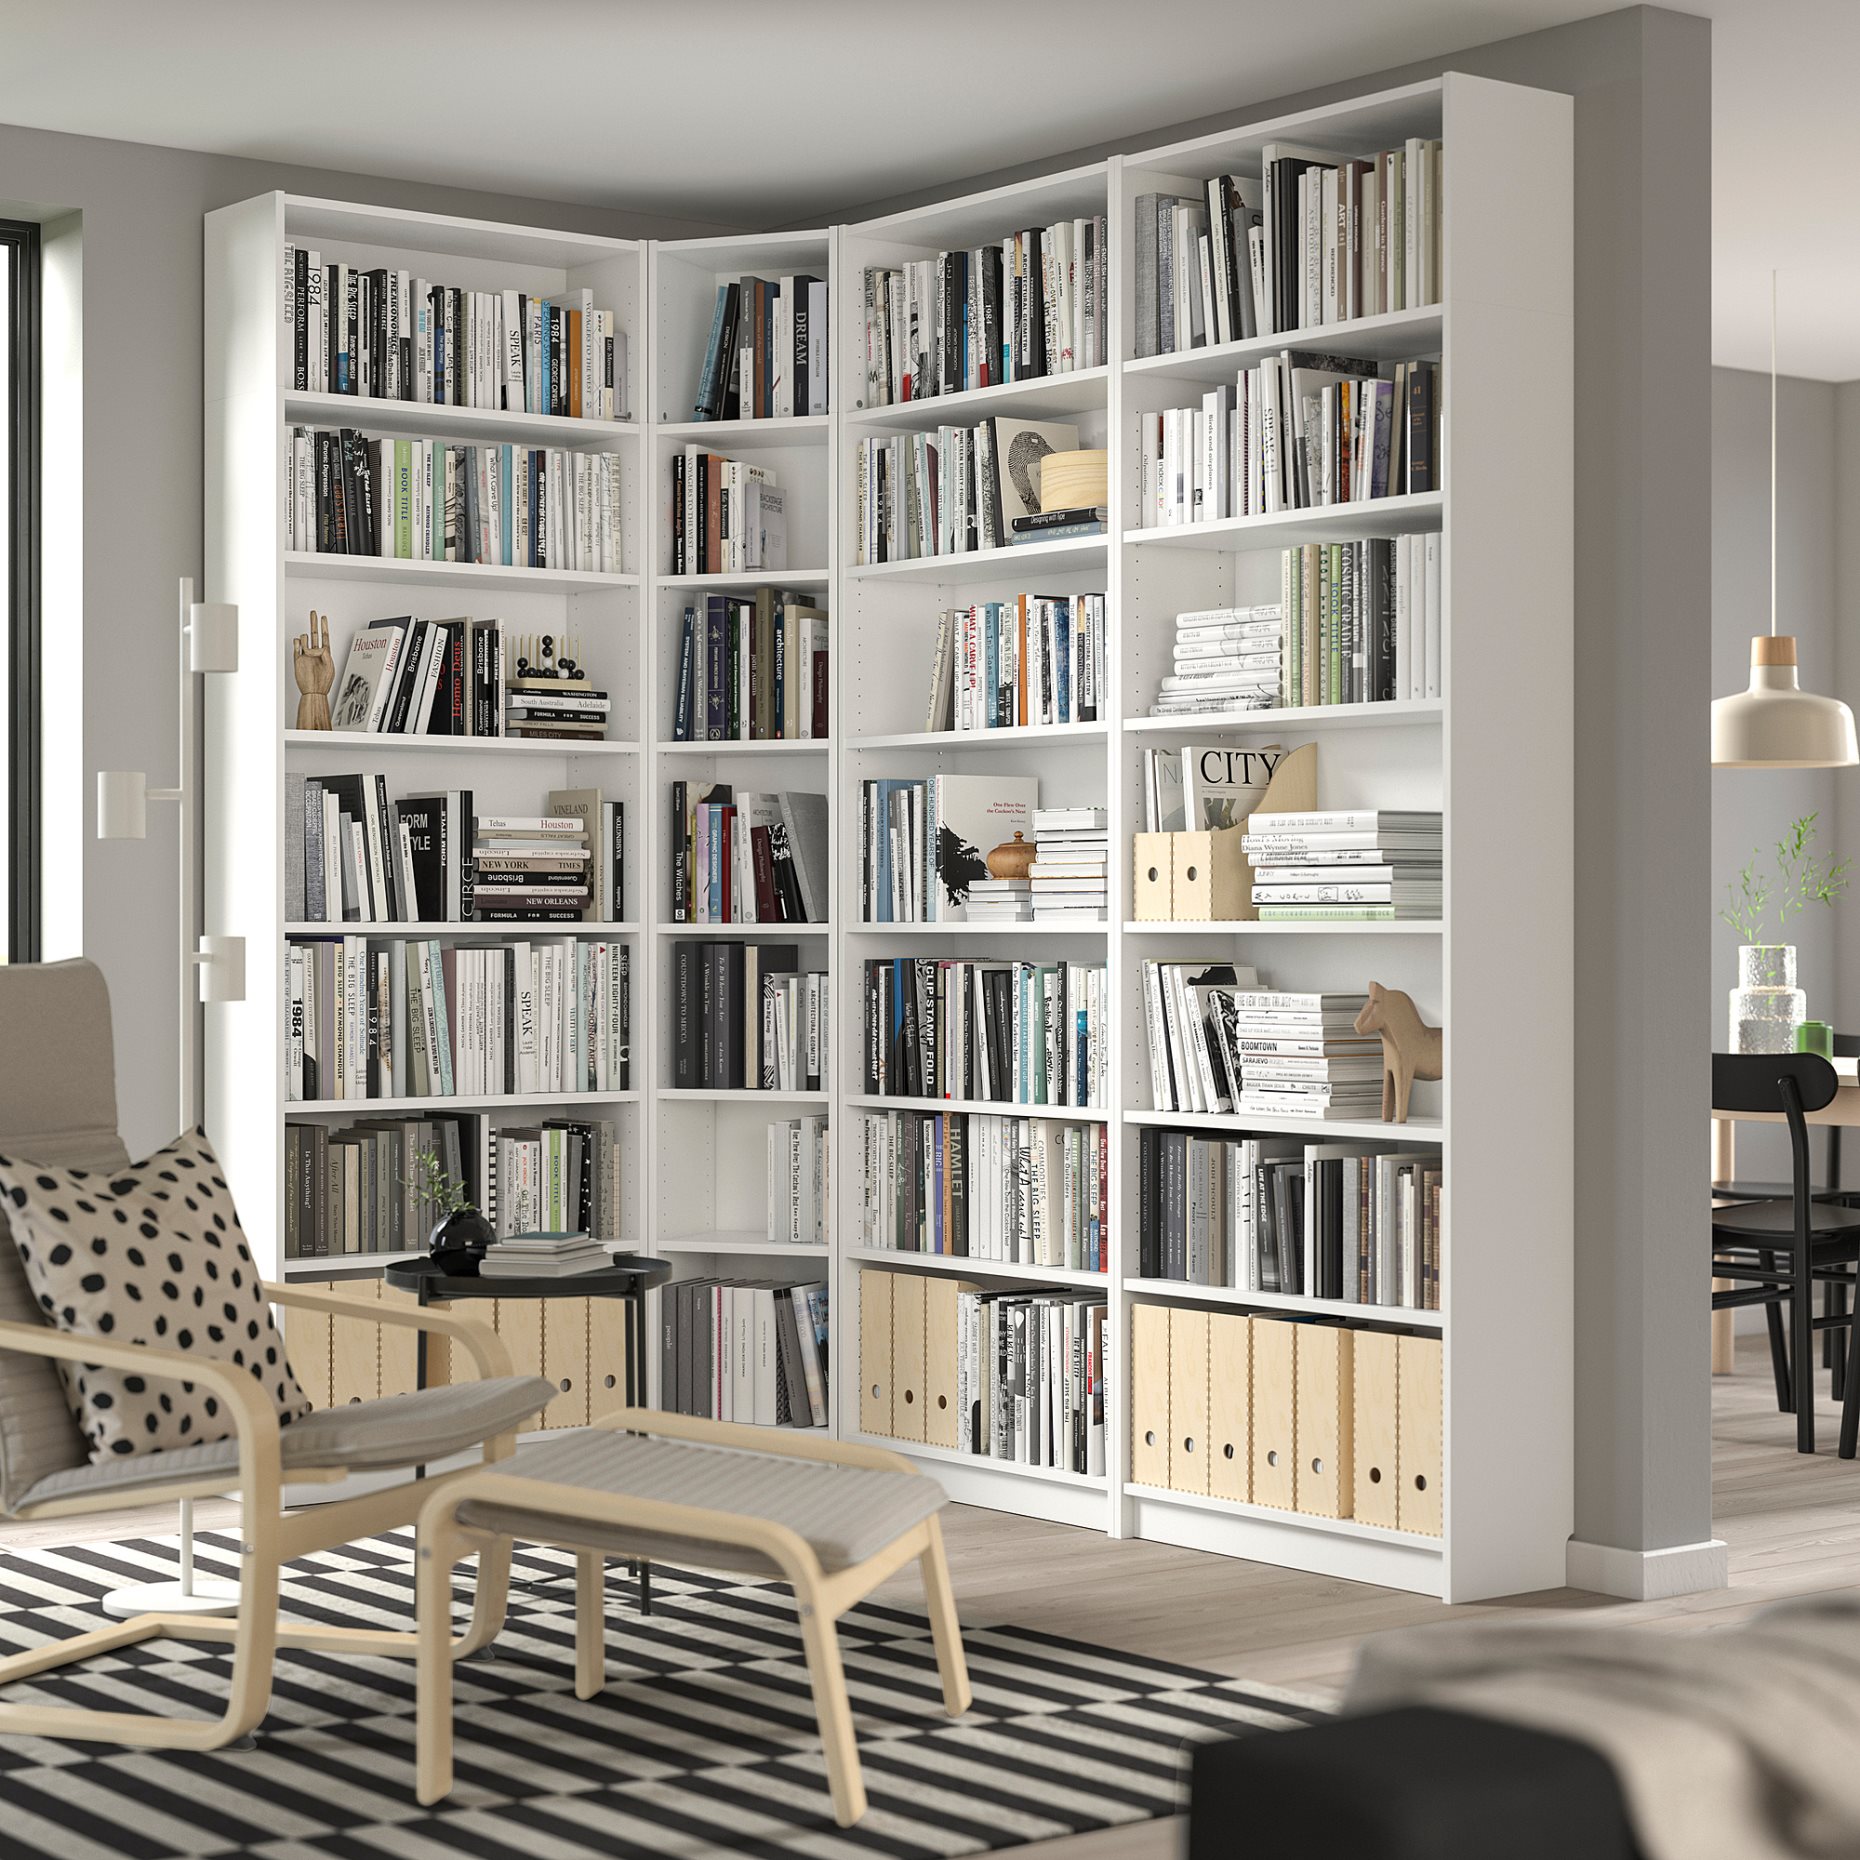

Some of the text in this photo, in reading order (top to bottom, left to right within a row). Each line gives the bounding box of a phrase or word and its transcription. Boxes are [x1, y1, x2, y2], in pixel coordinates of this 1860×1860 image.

[1380, 235, 1386, 244] in
[307, 267, 320, 305] 1984
[297, 287, 305, 331] PERFORM
[390, 274, 398, 355] FREAKONOMICS
[534, 316, 542, 345] PARIS
[796, 312, 807, 365] DREAM
[509, 330, 521, 367] SPEAK
[551, 318, 559, 408] 1984 GEORGE ORWELL
[586, 344, 592, 354] TO
[297, 367, 305, 390] BOSS
[688, 500, 693, 510] TO
[1341, 547, 1352, 659] COSMIC CRADLE
[968, 605, 977, 632] WHAT
[353, 638, 387, 652] Houston
[385, 638, 401, 672] Houston
[407, 635, 423, 673] Brisbane
[430, 638, 445, 679] FASHION
[776, 629, 784, 680] architecture
[968, 643, 977, 672] CARVE
[452, 641, 461, 717] Homo Deus
[968, 673, 977, 688] UP!
[395, 696, 406, 727] Queensland
[538, 699, 563, 707] Australia
[578, 701, 606, 709] Adelaide
[1200, 750, 1281, 786] CITY
[400, 814, 428, 829] FORM
[553, 804, 588, 815] VINELAND
[541, 820, 574, 829] Houston
[482, 861, 503, 869] NEW
[504, 861, 529, 869] YORK
[675, 852, 683, 901] The Witches
[928, 857, 934, 868] OF
[462, 857, 474, 917] CIRCE
[487, 874, 524, 883] Brisbane
[526, 897, 578, 906] NEW ORLEANS
[358, 951, 366, 965] One
[358, 967, 366, 993] Hundred
[611, 946, 619, 1034] NINETEEN EIGHTY-FOUR
[291, 998, 302, 1038] 1984
[358, 999, 366, 1016] Years
[409, 988, 421, 1054] THE BIG SLEEP
[521, 991, 533, 1036] SPEAK
[680, 1005, 687, 1016] TO
[926, 966, 934, 1084] CLIP STAMP FOLD
[358, 1028, 366, 1055] Solitude
[1241, 1041, 1277, 1051] BOOMTOWN
[330, 1159, 339, 1193] After All
[950, 1128, 963, 1199] HAMLET
[1038, 1140, 1046, 1201] COMMODITIES
[1259, 1183, 1265, 1192] AT
[665, 1325, 673, 1350] people
